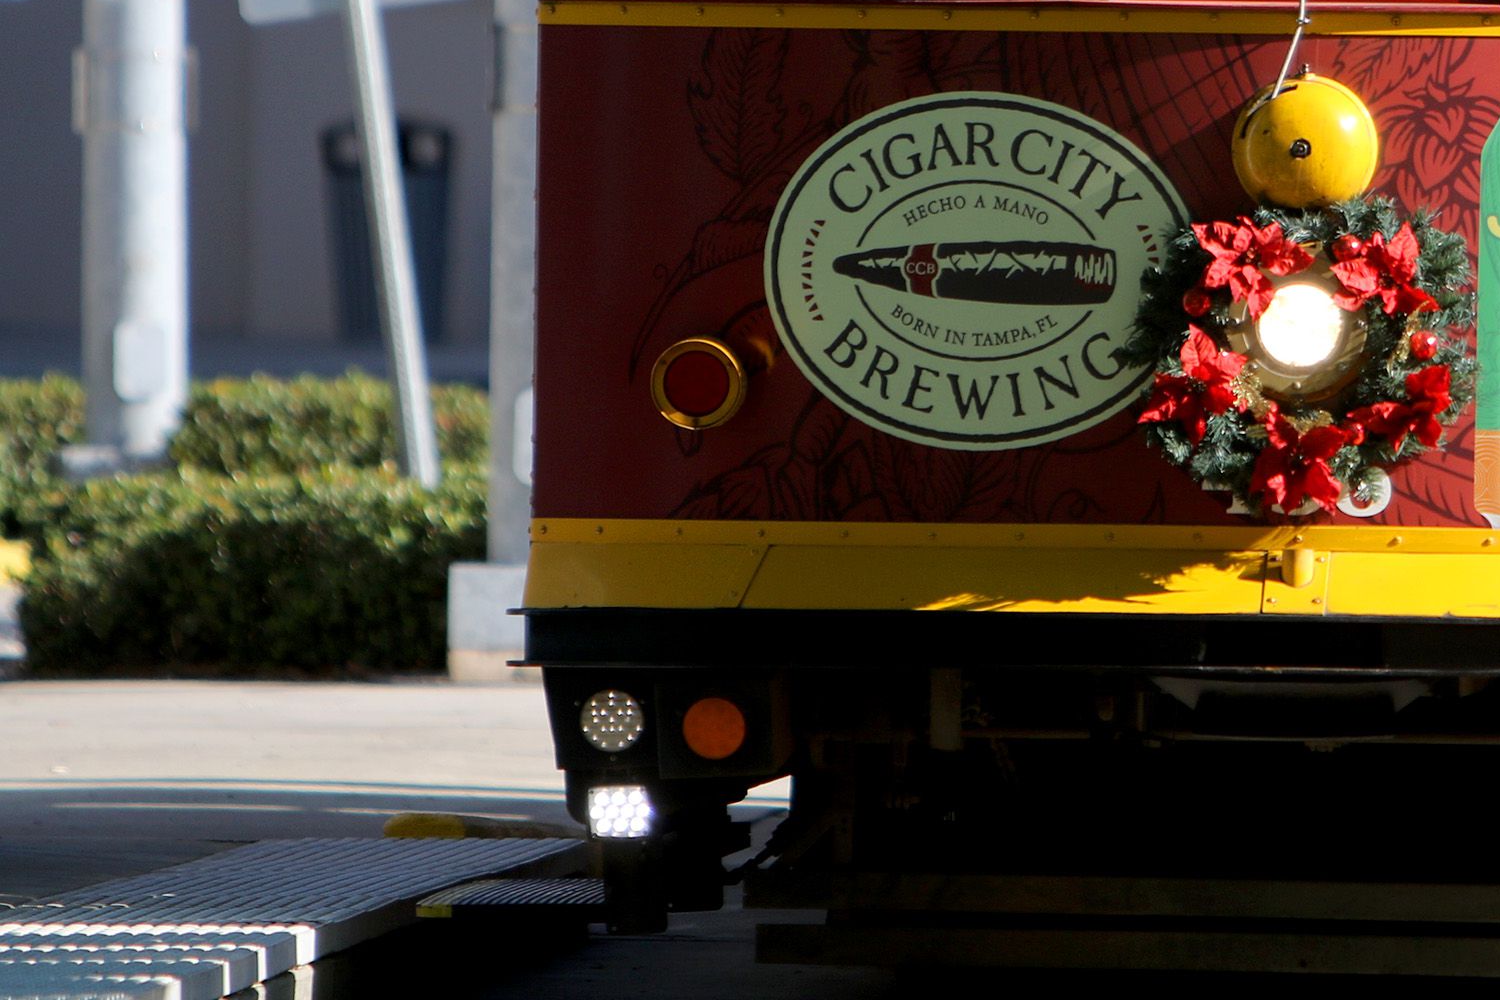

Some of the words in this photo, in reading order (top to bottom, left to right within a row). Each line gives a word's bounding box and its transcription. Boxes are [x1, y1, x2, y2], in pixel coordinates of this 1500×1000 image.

[828, 122, 999, 214] CIGAR
[1010, 128, 1143, 221] CITY
[902, 195, 966, 227] HECHO
[974, 195, 986, 209] A
[993, 196, 1049, 226] MANO
[905, 261, 936, 275] CCB
[890, 304, 939, 339] BORN
[944, 329, 967, 346] IN
[823, 319, 1129, 421] BREWING
